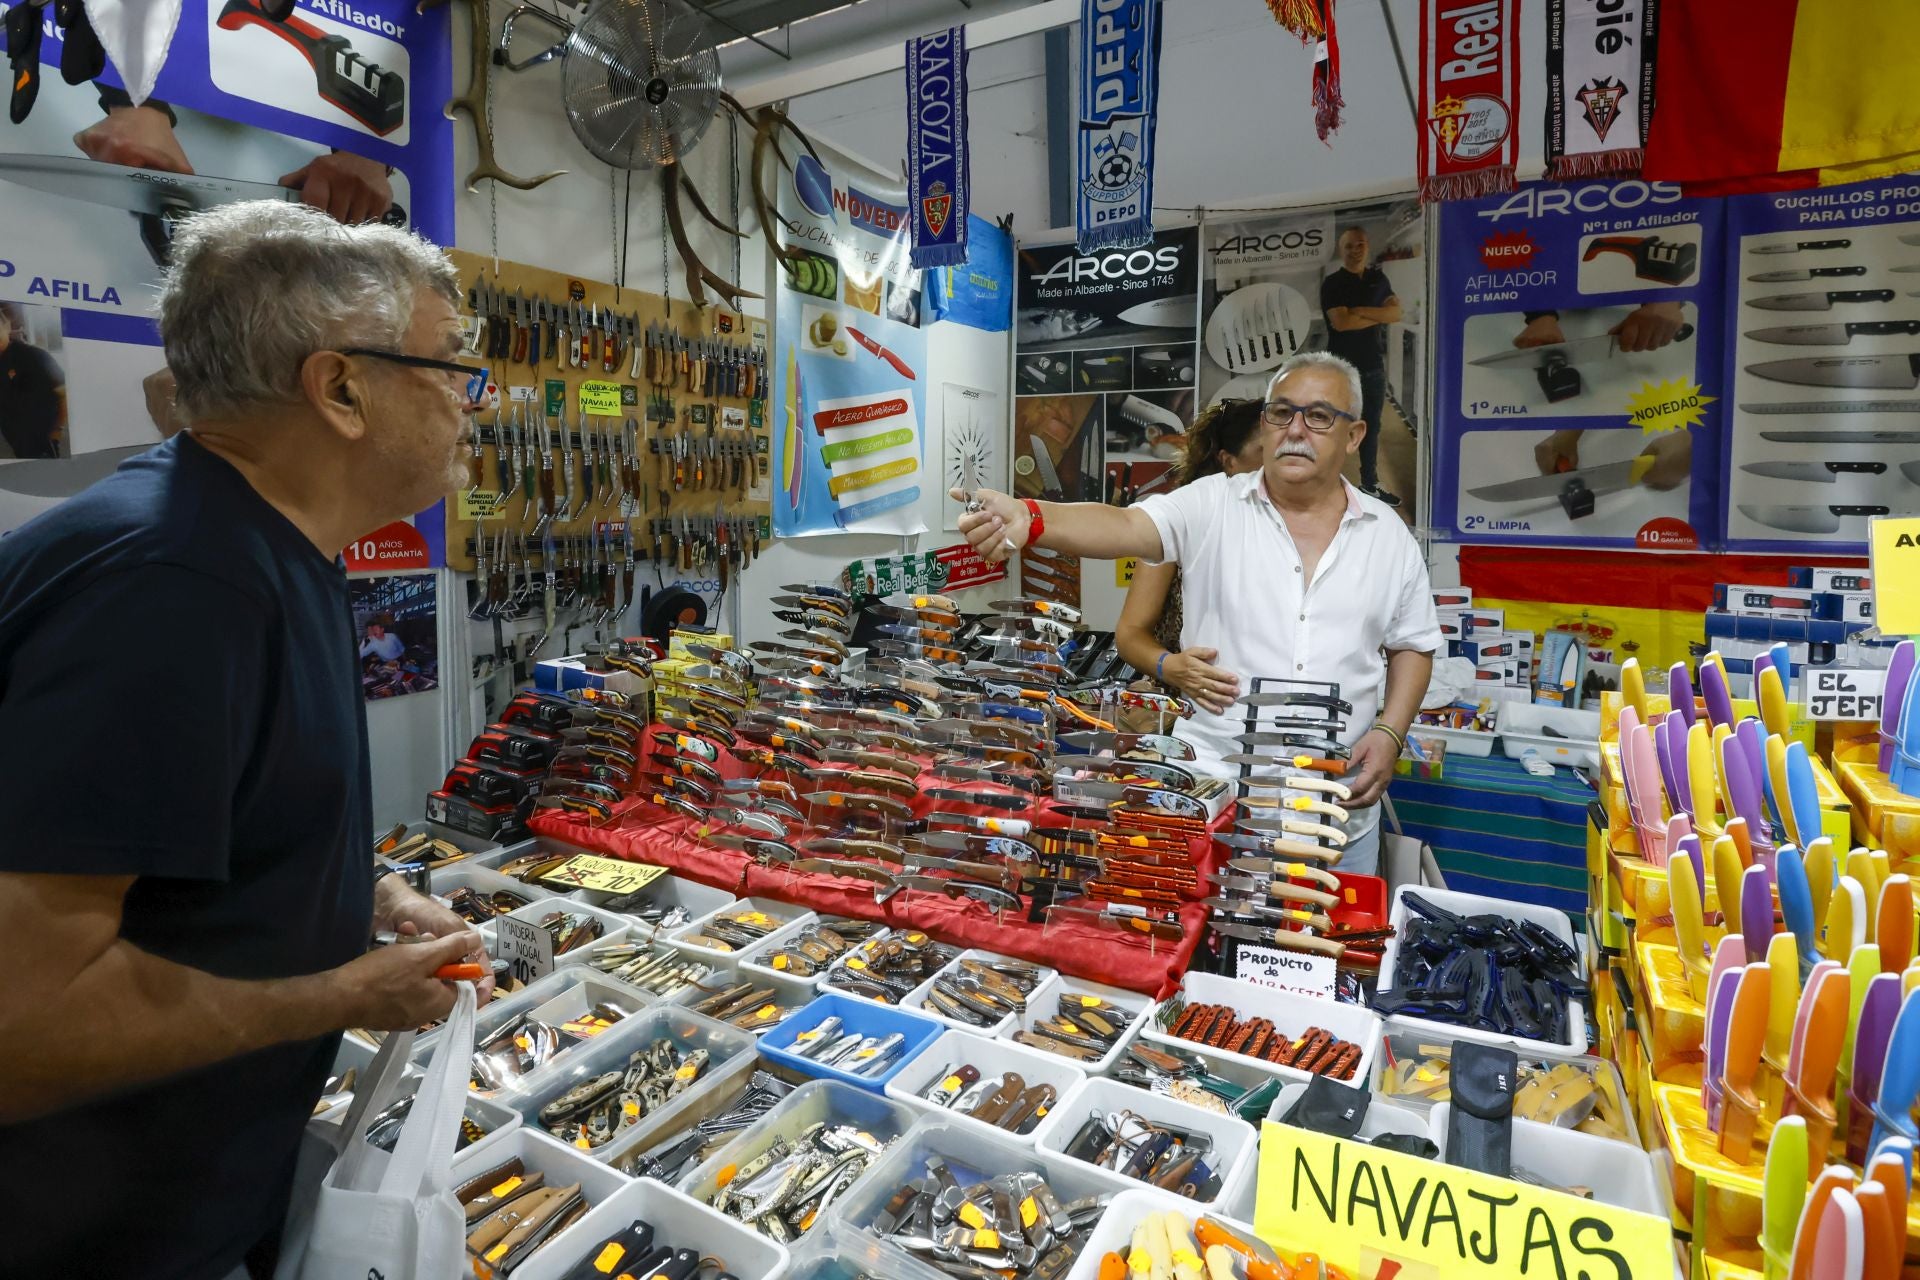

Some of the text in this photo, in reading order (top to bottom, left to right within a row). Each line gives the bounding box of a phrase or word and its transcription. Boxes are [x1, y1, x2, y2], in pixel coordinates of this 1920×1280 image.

[1440, 0, 1500, 82] Real
[1643, 62, 1653, 101] albacete
[1552, 75, 1560, 111] albacete
[1087, 176, 1144, 201] SUPPORTERS
[1477, 180, 1683, 222] ARCOS
[1774, 190, 1875, 209] CUCHILLOS
[1096, 204, 1136, 222] DEPO
[1614, 219, 1632, 230] en
[1636, 211, 1699, 227] Afilador
[1799, 210, 1846, 223] PARA
[1851, 205, 1890, 219] USO
[1208, 229, 1323, 256] ARCOS
[1485, 244, 1531, 257] NUEVO
[1031, 247, 1180, 286] ARCOS
[1213, 257, 1233, 266] Made
[1234, 256, 1241, 264] in
[27, 277, 122, 305] AFILA
[1037, 288, 1062, 299] Made
[1065, 286, 1073, 296] in
[1074, 283, 1114, 295] Albacete
[1122, 279, 1148, 291] Since
[1151, 274, 1175, 287] 1745
[1464, 270, 1557, 291] AFILADOR
[1464, 291, 1518, 304] DE MANO
[1470, 401, 1528, 415] 1º AFILA
[1634, 395, 1699, 422] NOVEDAD
[1464, 515, 1531, 531] 2º LIMPIA
[1640, 530, 1660, 543] 10
[350, 540, 403, 560] 10 AÑOS
[379, 549, 423, 559] GARANTÍA
[877, 570, 929, 594] Real Betis
[1818, 673, 1857, 692] EL
[502, 919, 537, 944] MADERA
[504, 940, 543, 965] DE NOGAL
[1239, 951, 1313, 972] PRODUCTO
[1264, 966, 1279, 977] de
[1291, 1143, 1634, 1280] NAVAJAS
